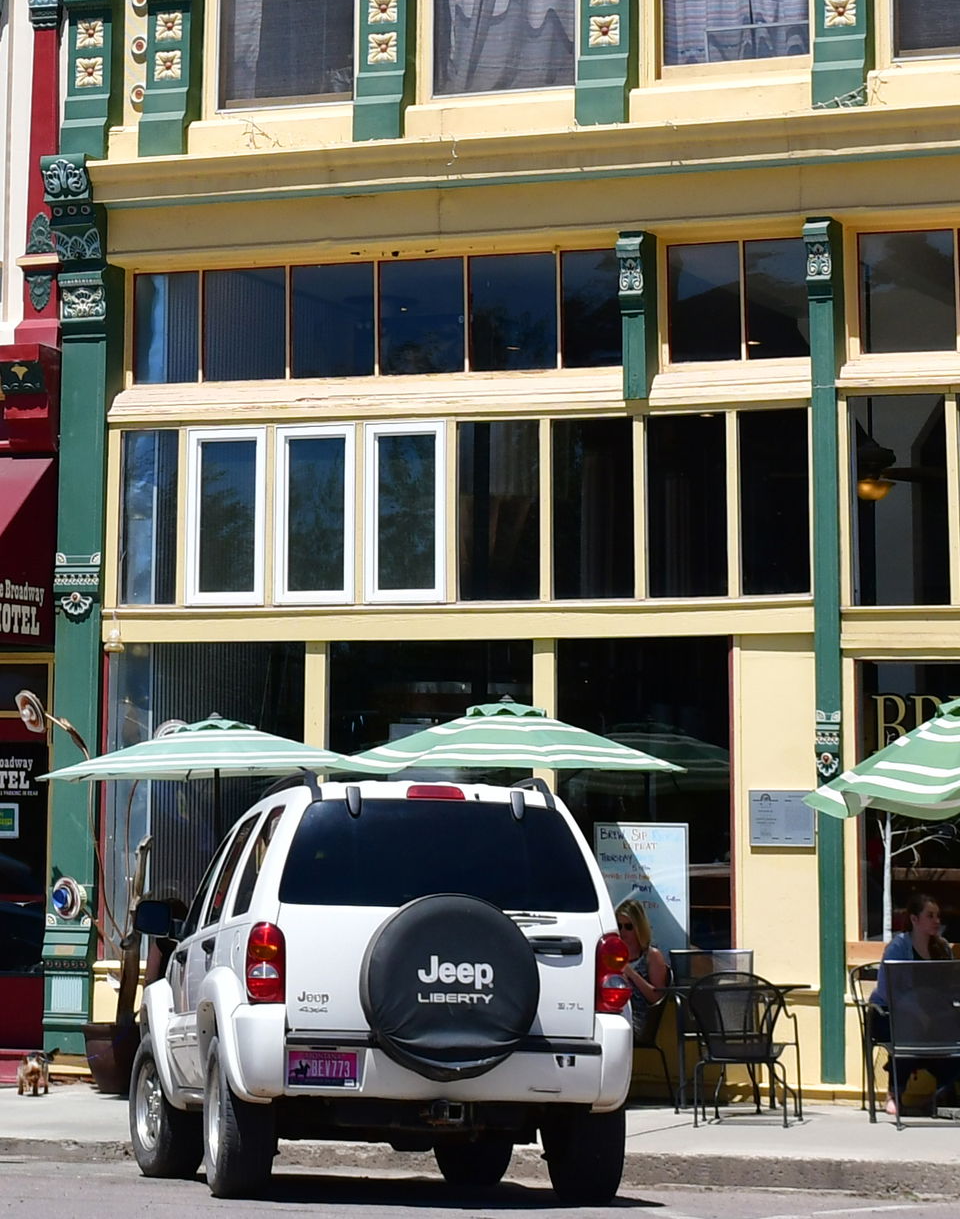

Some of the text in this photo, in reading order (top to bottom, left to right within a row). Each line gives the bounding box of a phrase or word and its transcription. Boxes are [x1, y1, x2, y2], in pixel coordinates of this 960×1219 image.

[5, 579, 45, 607] Broadway
[418, 955, 494, 989] Jeep
[297, 991, 329, 1004] Jeep
[418, 992, 494, 1004] LIBERTY
